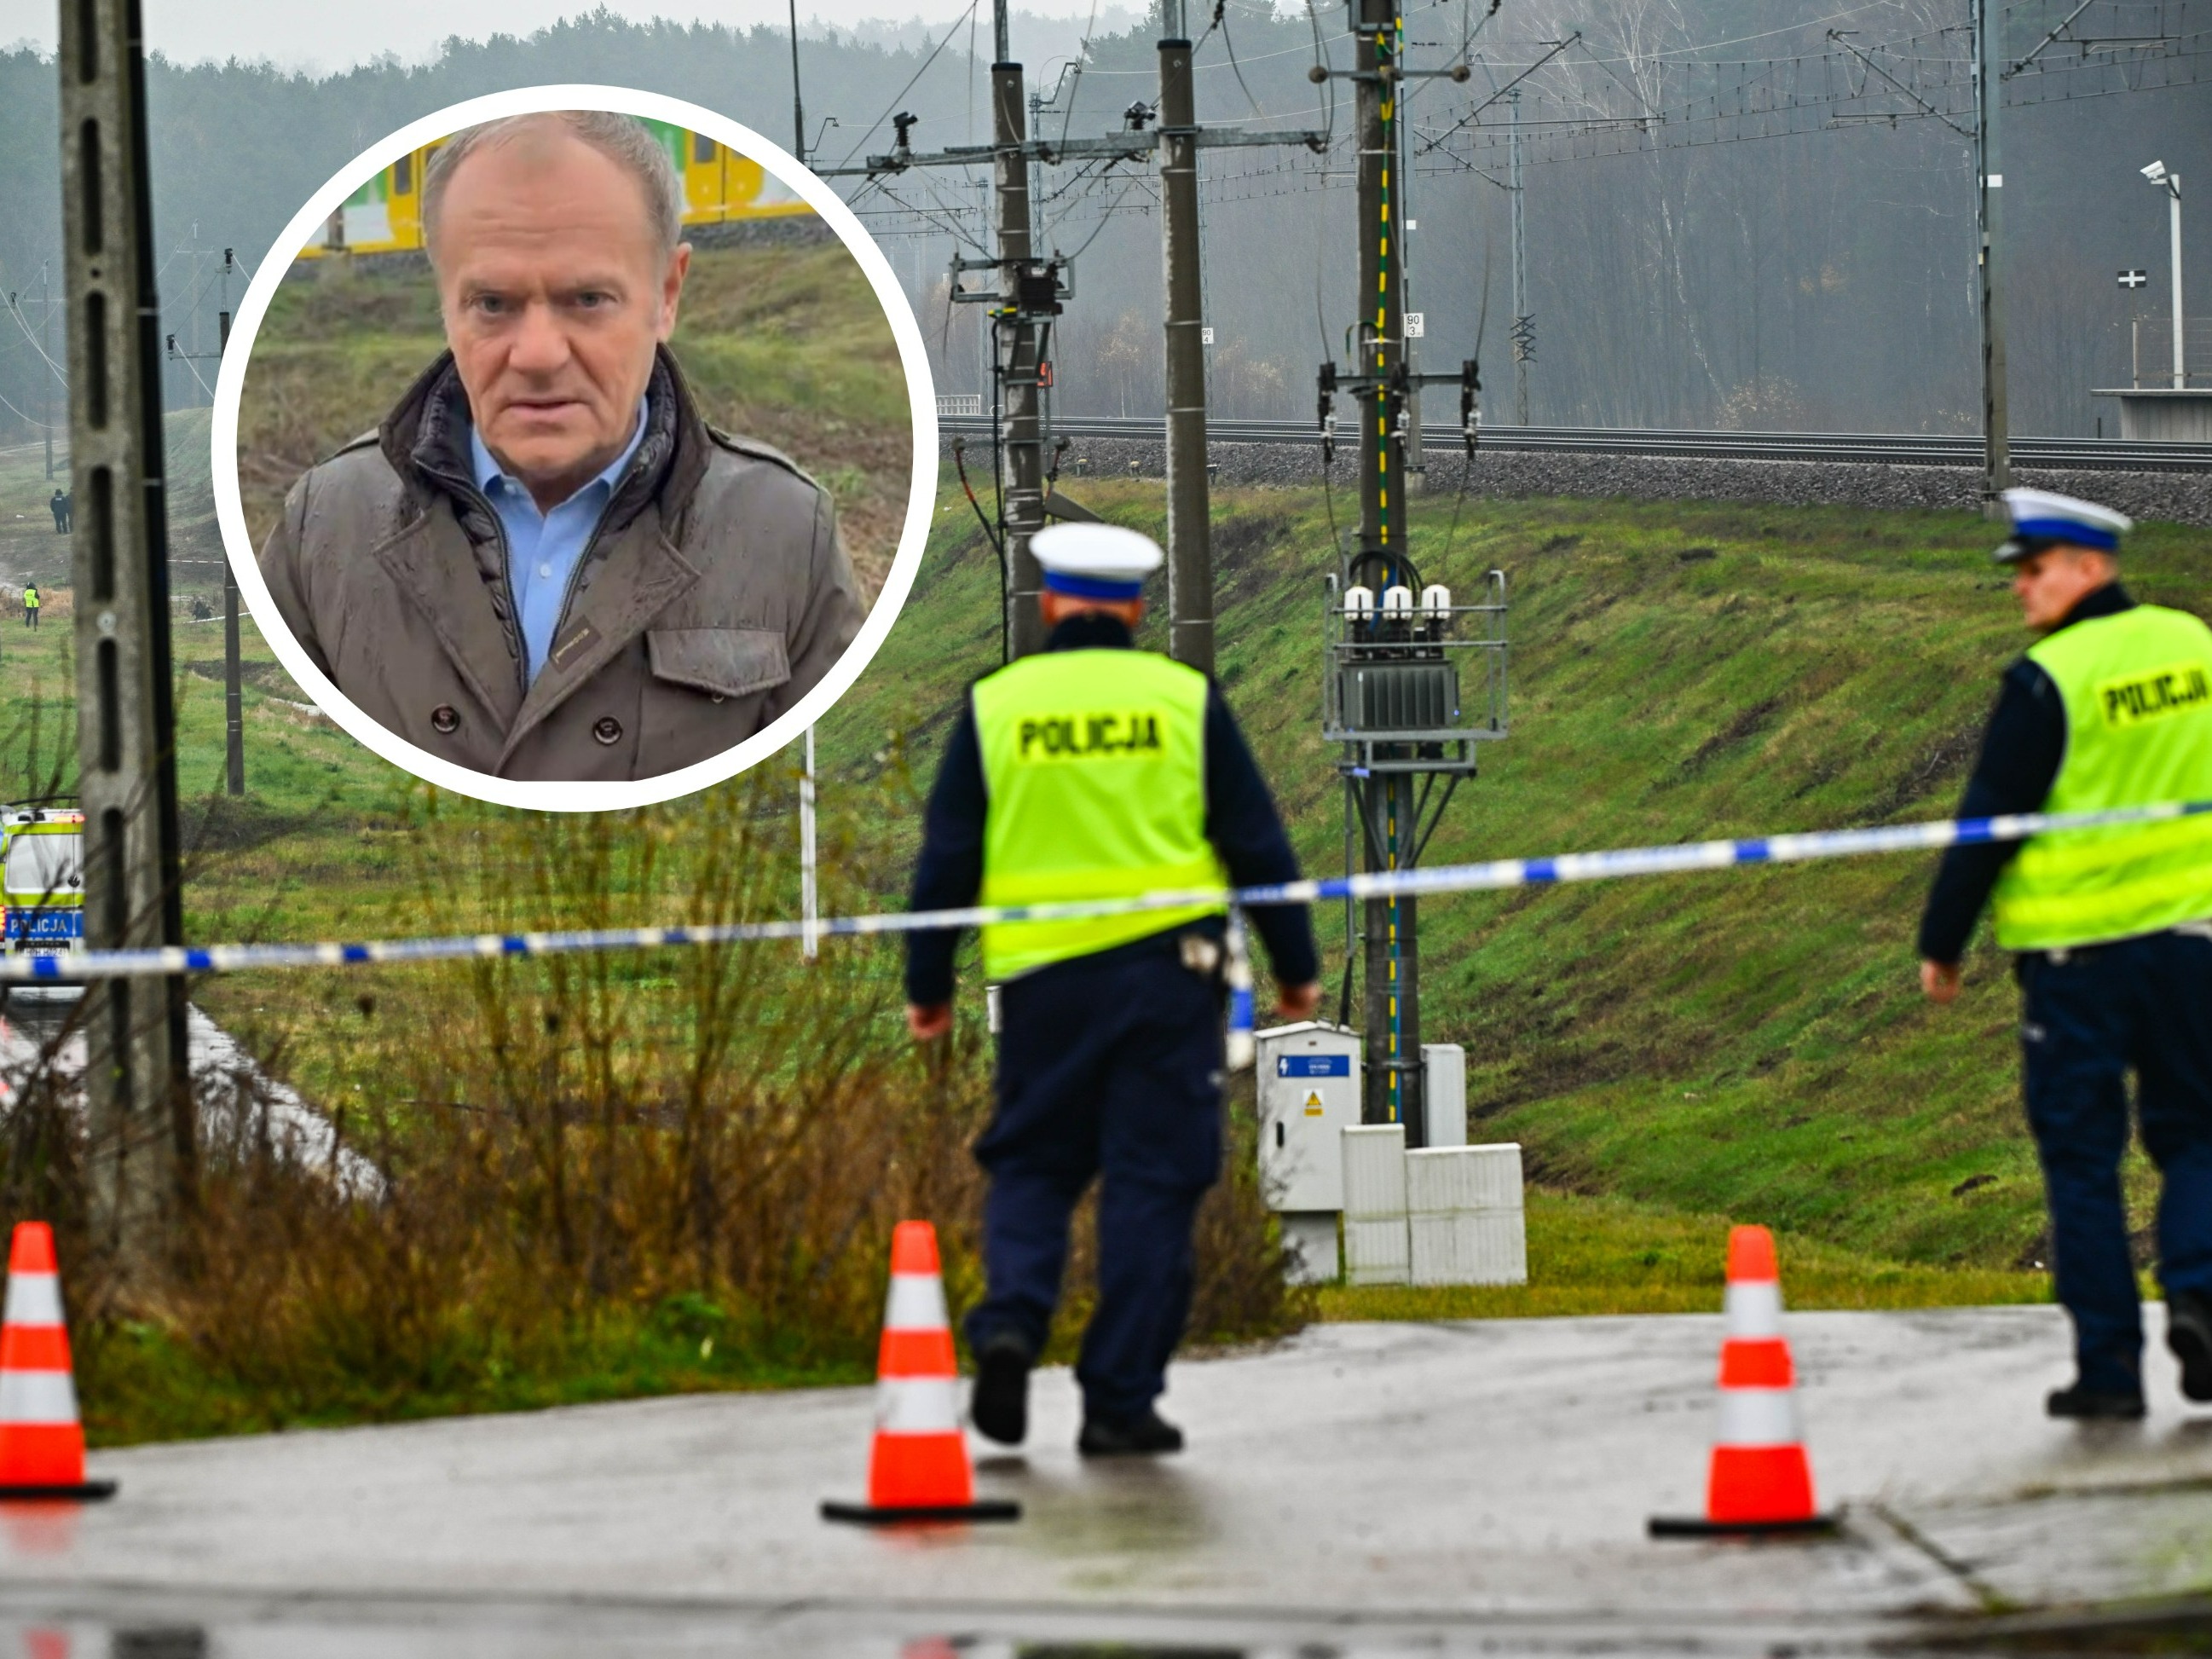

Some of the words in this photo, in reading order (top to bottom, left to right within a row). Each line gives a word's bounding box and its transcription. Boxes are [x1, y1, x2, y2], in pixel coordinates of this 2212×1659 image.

[1407, 315, 1419, 325] 90
[1409, 327, 1415, 336] 3
[2106, 670, 2208, 724] POLICJA
[1021, 716, 1160, 755] POLICJA
[10, 918, 67, 934] POLICJA
